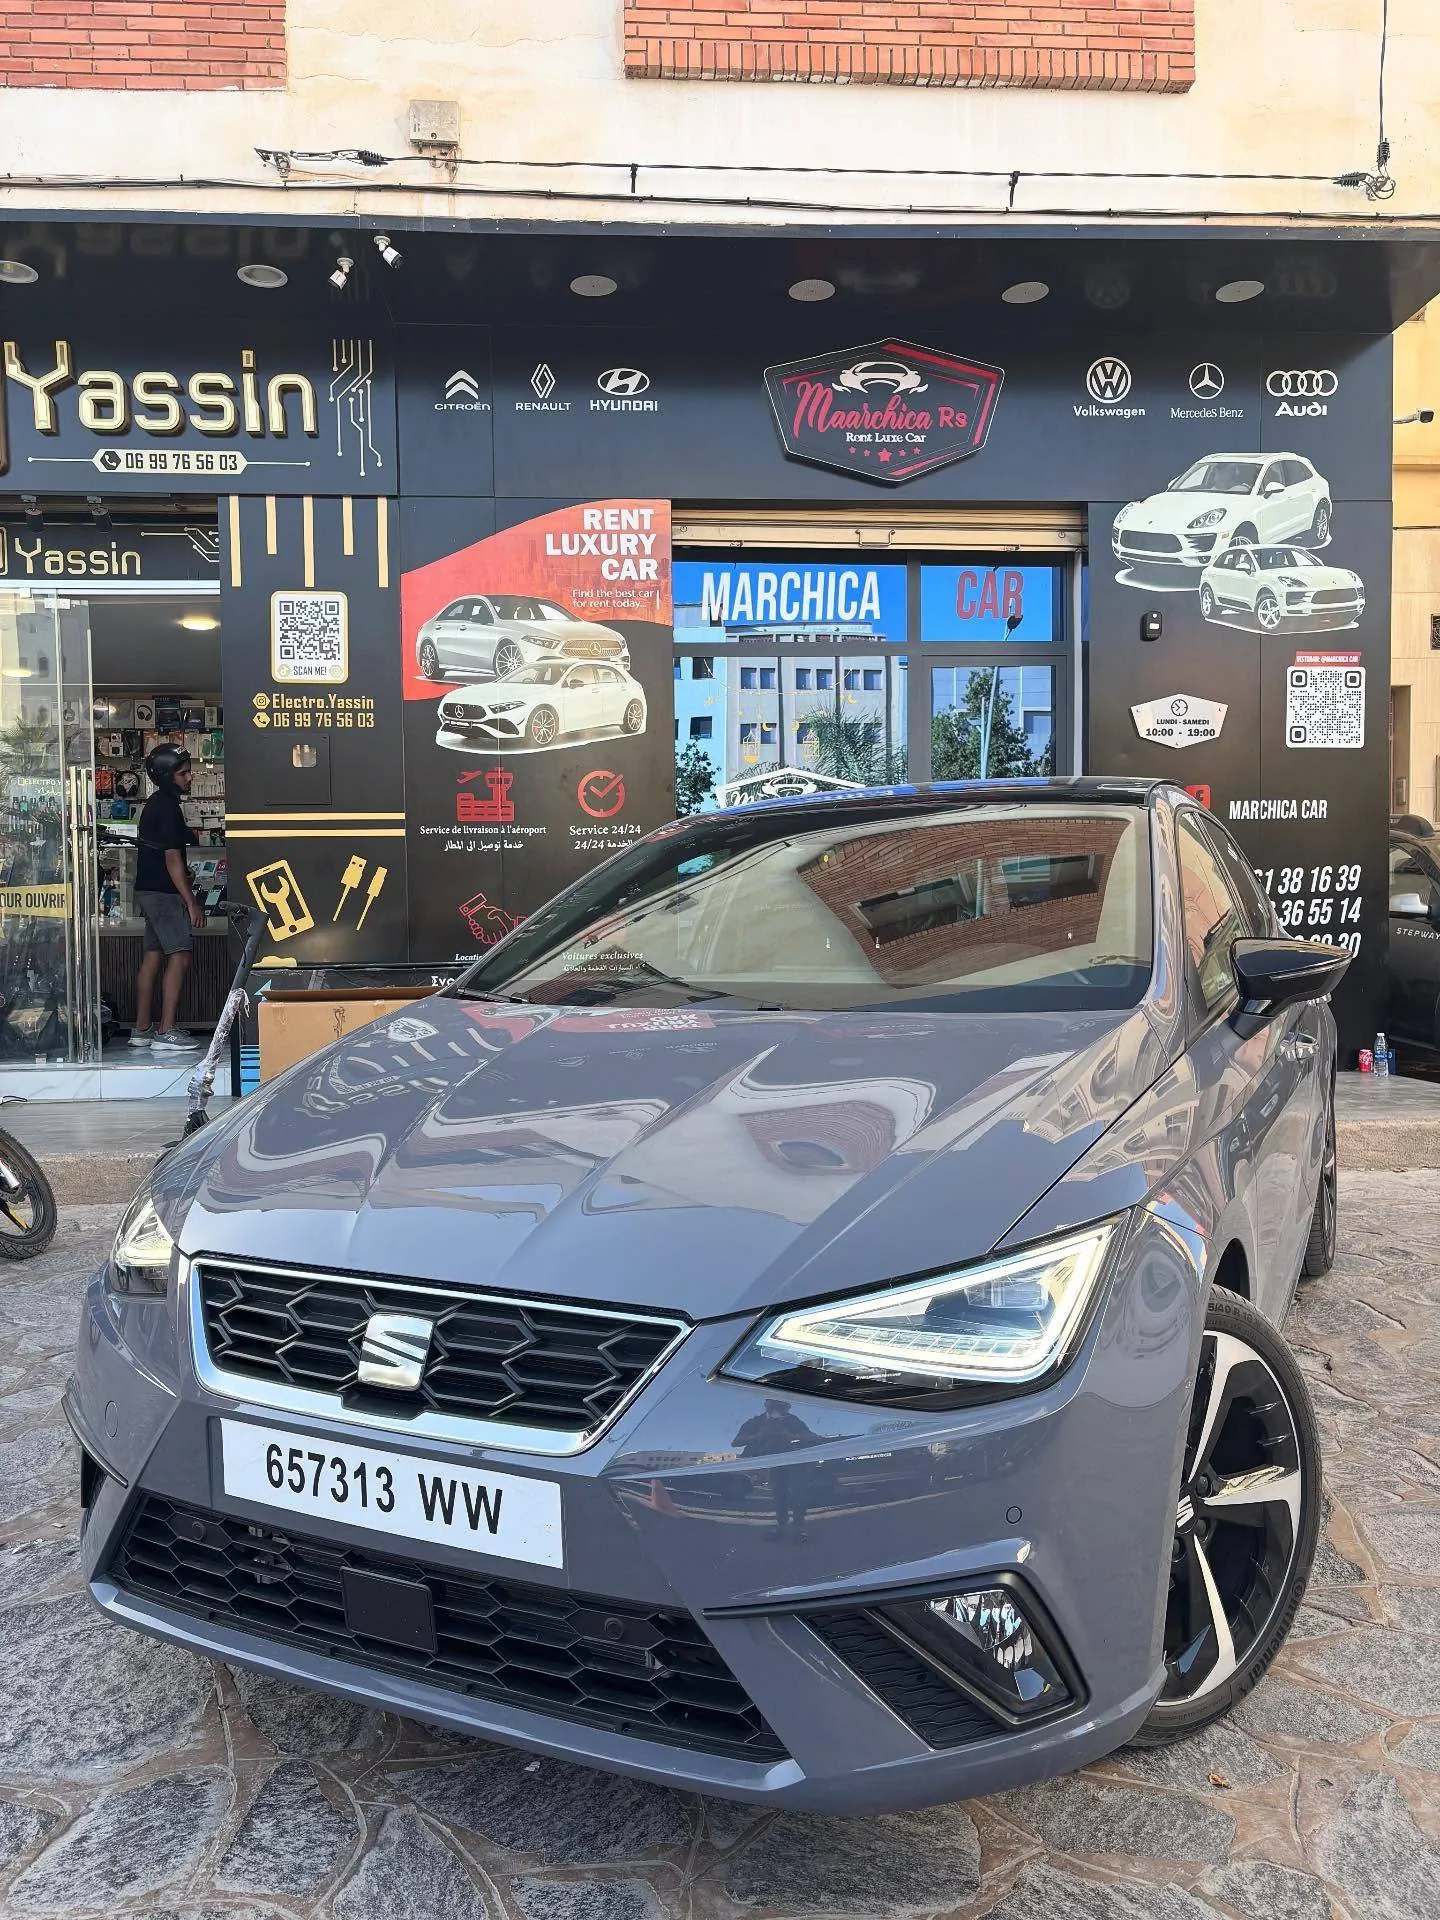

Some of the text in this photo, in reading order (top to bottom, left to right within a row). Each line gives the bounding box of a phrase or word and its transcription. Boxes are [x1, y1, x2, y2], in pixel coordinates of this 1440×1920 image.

[3, 341, 318, 436] Yassin
[434, 401, 491, 411] CITROËN
[515, 402, 572, 411] RENAULT
[589, 399, 658, 412] HYUNDAI
[793, 381, 969, 439] Maarchica Rs
[1073, 405, 1146, 419] Volkswagen
[1274, 402, 1328, 417] Audi
[1219, 407, 1244, 418] Benz
[846, 432, 926, 443] Rent Luxe Car
[125, 454, 238, 471] 06 99 76 56 03
[583, 508, 655, 531] RENT
[545, 533, 657, 556] LUXURY
[15, 538, 142, 576] Yassin
[601, 558, 659, 581] CAR
[572, 589, 654, 599] Find the best car
[700, 569, 1025, 622] MARCHICA CAR
[572, 599, 588, 609] for
[590, 600, 611, 608] rent
[293, 665, 327, 676] SCAN ME!
[272, 693, 375, 710] Electro.Yassin
[273, 712, 375, 728] 06 99 76 56 03
[1145, 728, 1174, 737] 10:00
[1187, 728, 1216, 737] 19:00
[1229, 799, 1328, 820] MARCHICA CAR
[419, 825, 450, 835] Service
[451, 825, 462, 834] de
[463, 825, 499, 835] livraison
[507, 825, 547, 837] l'aéroport
[569, 823, 642, 836] Service 24/24
[443, 840, 464, 852] المطار
[477, 840, 501, 852] توصيل
[503, 840, 524, 850] خدمة
[574, 839, 605, 850] 24/24
[1277, 866, 1305, 895] 38
[1310, 865, 1333, 893] 16
[1335, 864, 1362, 892] 39
[1279, 896, 1362, 927] 36 55 14
[1396, 927, 1440, 940] STEPWAY
[562, 951, 644, 960] Voitures exclusives
[265, 1443, 503, 1536] 657313 WW
